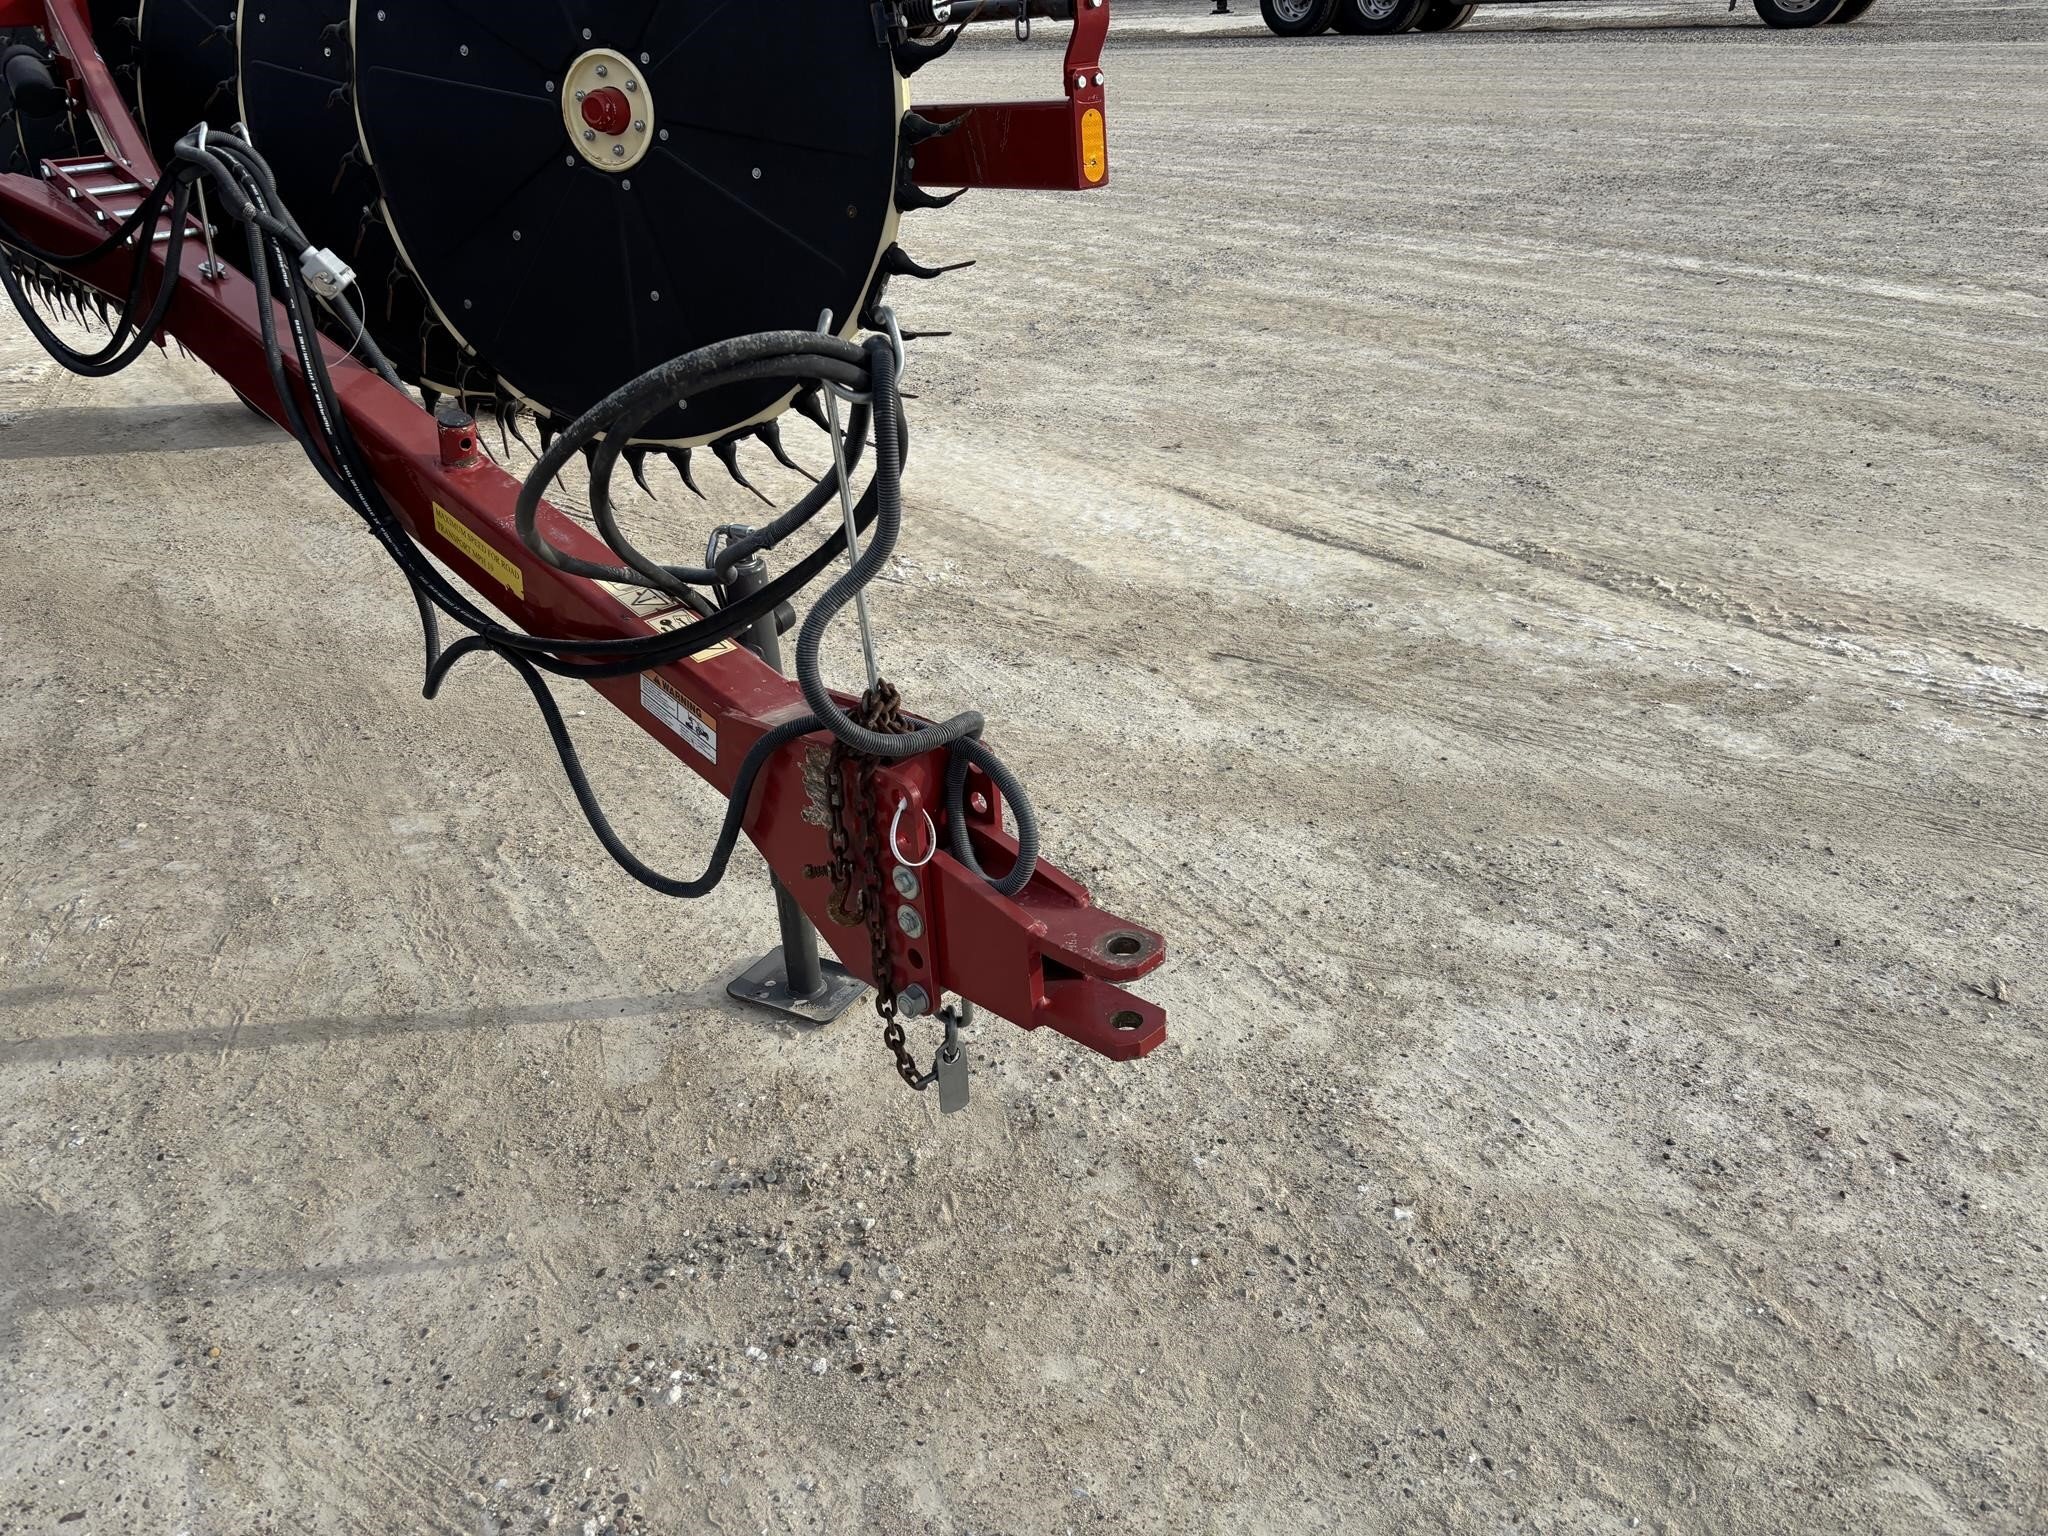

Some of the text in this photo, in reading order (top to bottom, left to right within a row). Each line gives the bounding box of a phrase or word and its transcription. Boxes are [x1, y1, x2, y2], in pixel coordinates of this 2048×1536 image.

[435, 507, 520, 580] MAXIMUM SPEED FOR ROAD
[437, 520, 471, 554] TRANSPORT
[472, 549, 487, 566] MPH
[663, 681, 702, 719] WARNING
